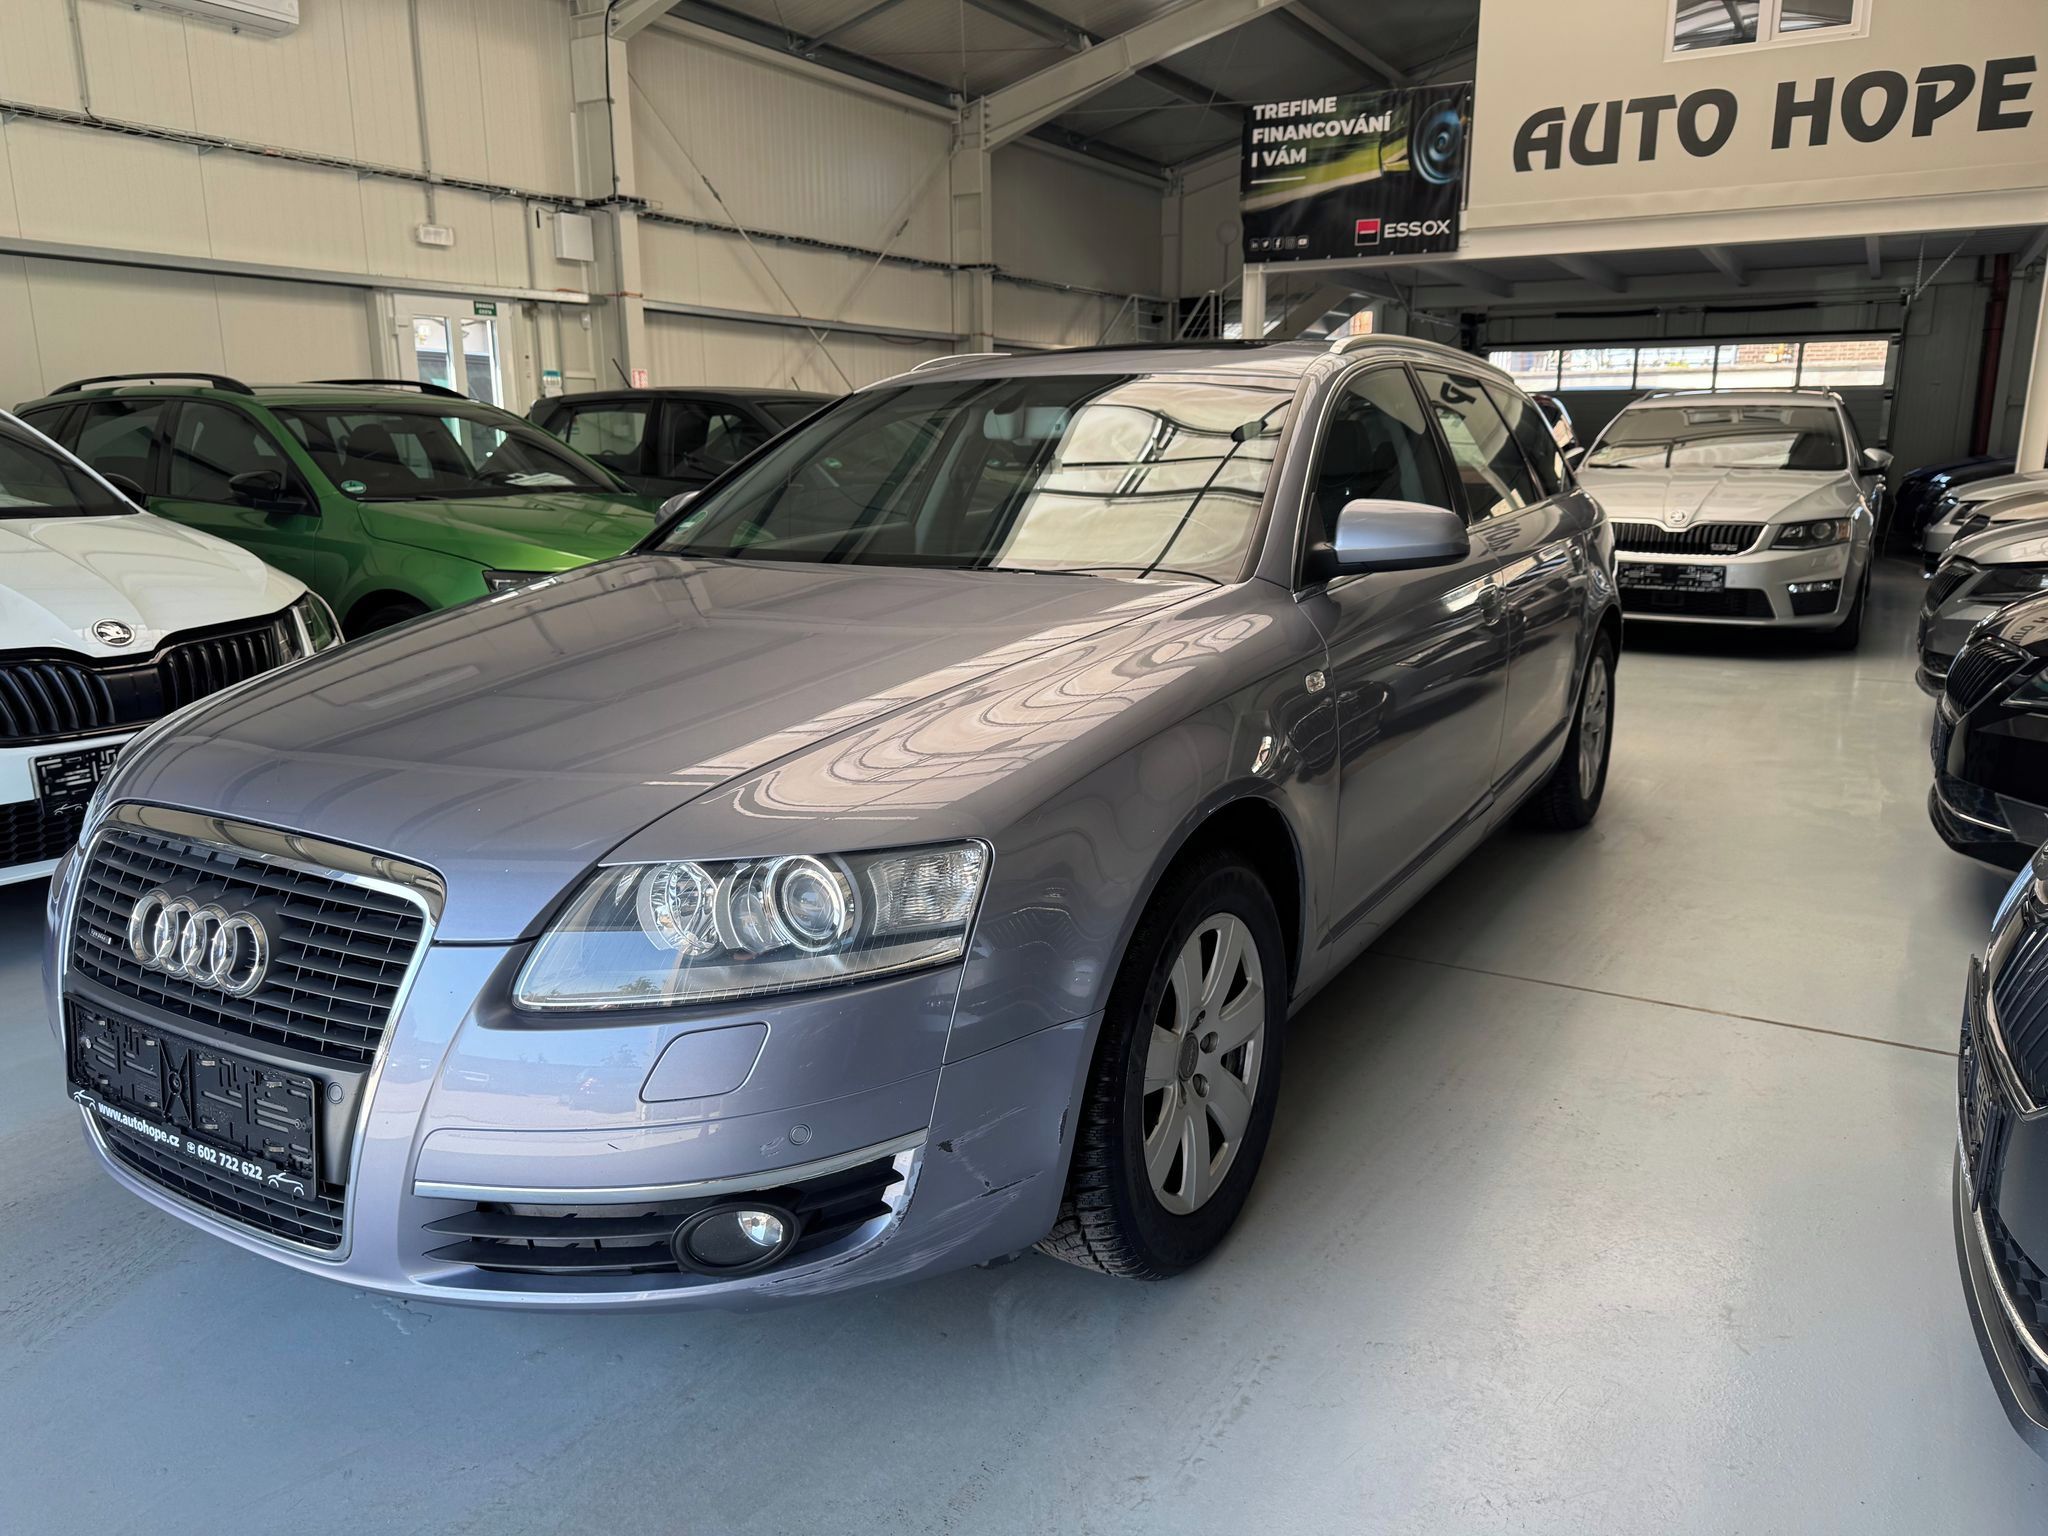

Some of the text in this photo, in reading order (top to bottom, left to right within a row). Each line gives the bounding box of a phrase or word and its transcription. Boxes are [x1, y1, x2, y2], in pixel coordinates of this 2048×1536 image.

[1253, 97, 1337, 120] TREFIME
[1513, 55, 2037, 172] AUTO HOPE
[1252, 111, 1392, 144] FINANCOVÁNÍ
[1251, 148, 1307, 168] I VÁM
[1384, 219, 1451, 239] ESSOX
[98, 1102, 180, 1148] www.autohope.cz
[197, 1145, 217, 1164] 602
[219, 1152, 239, 1173] 722
[241, 1162, 263, 1180] 622
